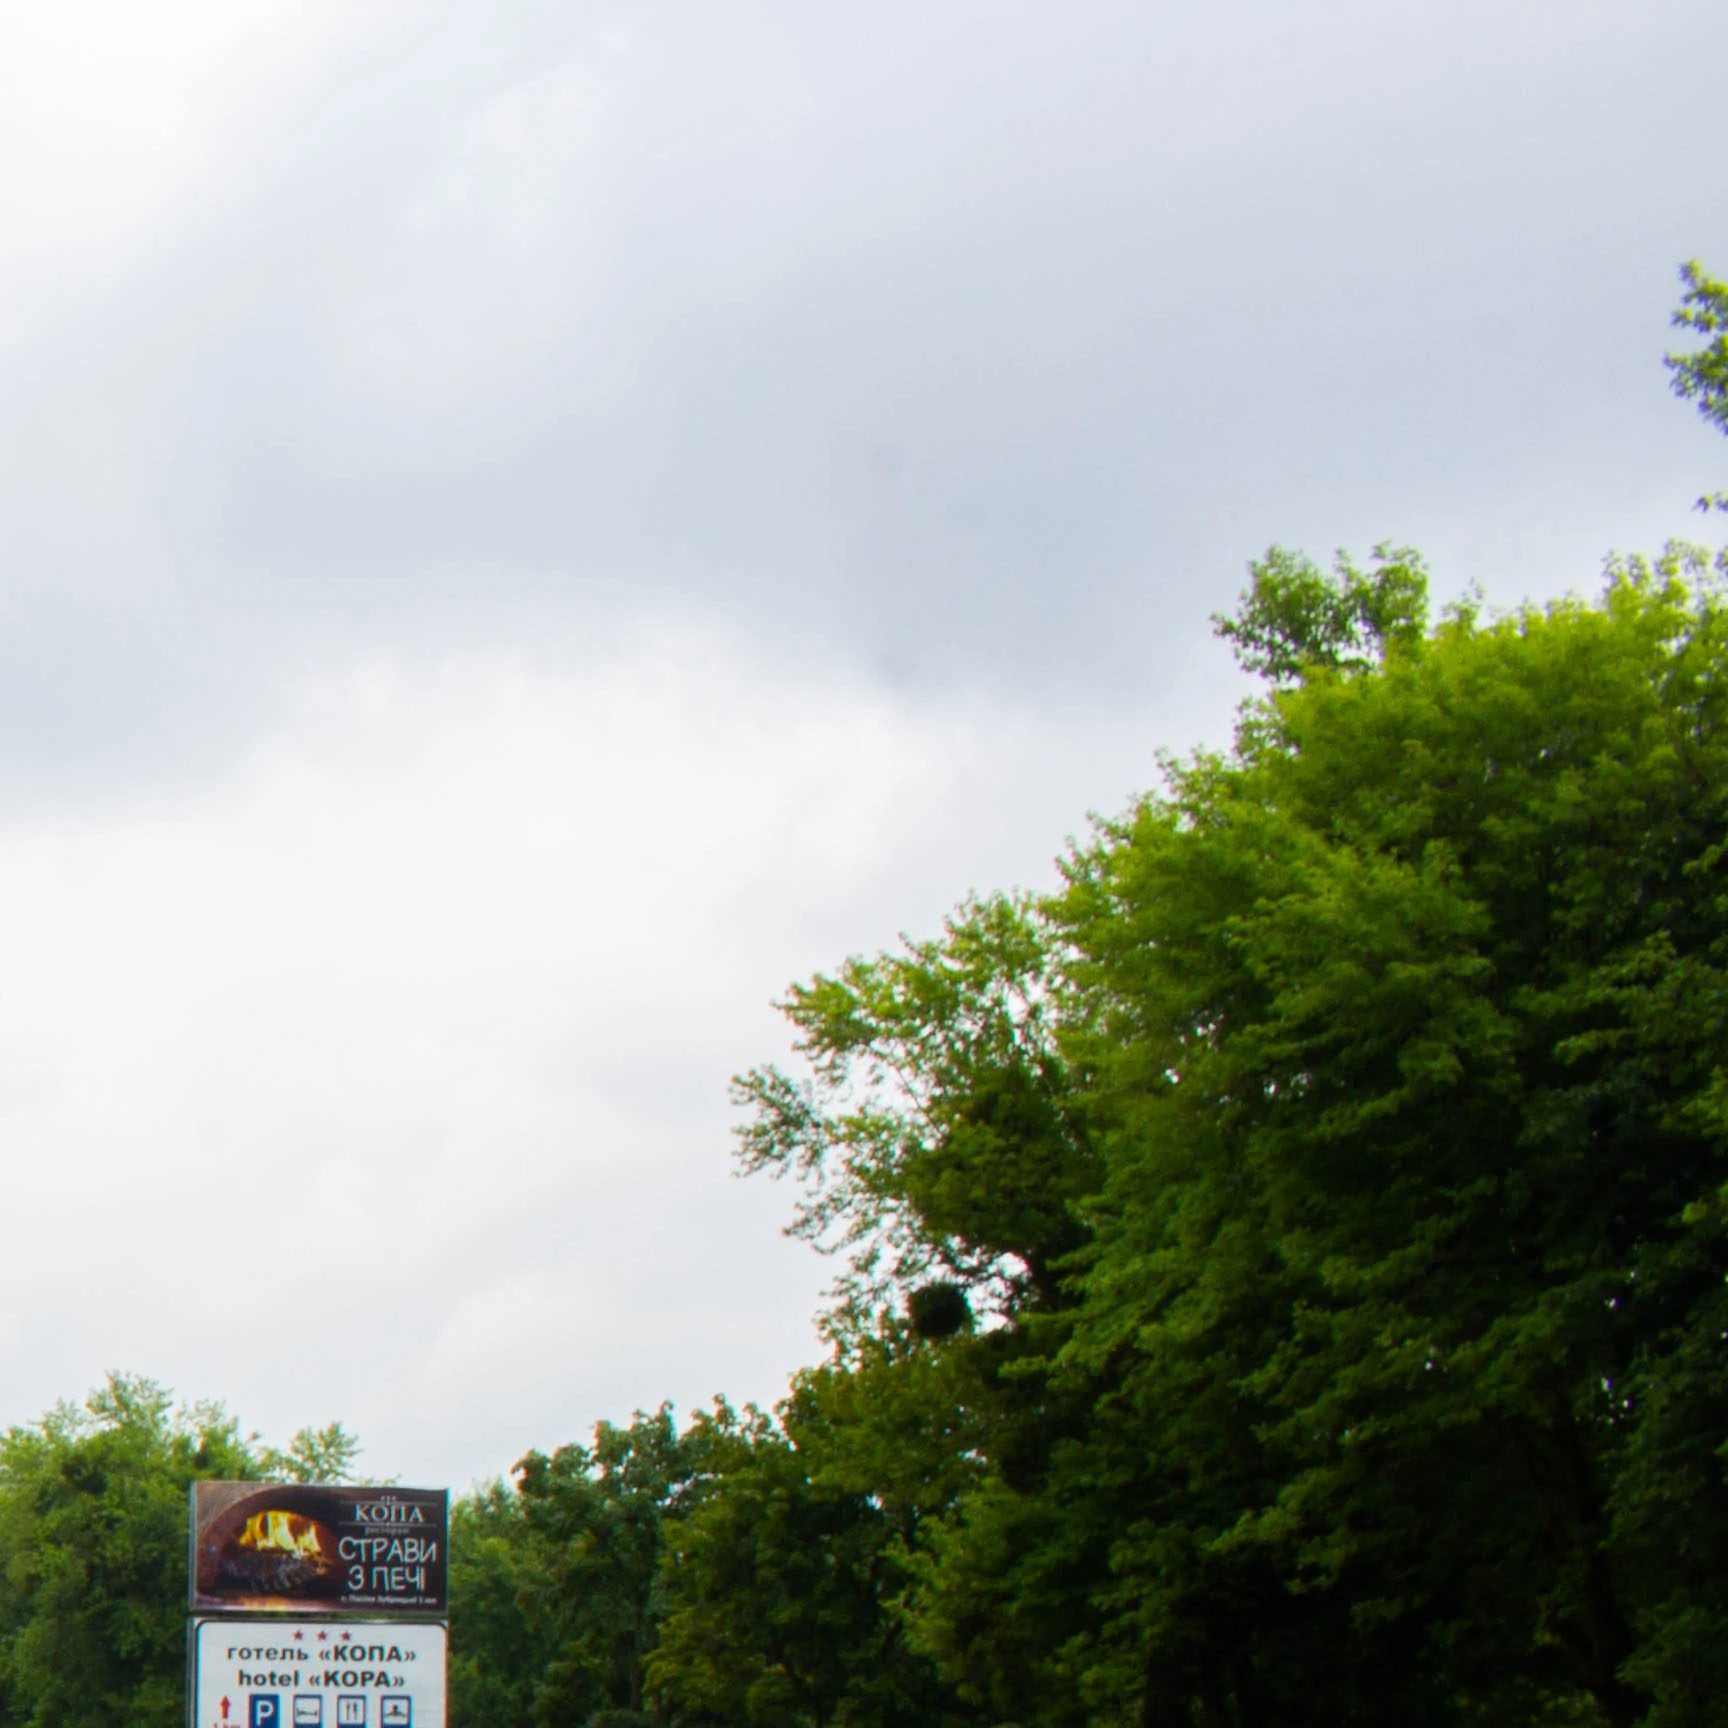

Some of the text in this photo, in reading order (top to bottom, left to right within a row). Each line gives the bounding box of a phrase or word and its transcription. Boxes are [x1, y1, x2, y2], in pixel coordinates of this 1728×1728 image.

[355, 1504, 424, 1522] КОПА
[338, 1536, 437, 1563] СТРАВИ
[371, 1565, 426, 1591] ПЕЧІ
[226, 1645, 416, 1662] готель «КОПА»
[238, 1669, 300, 1687] hotel
